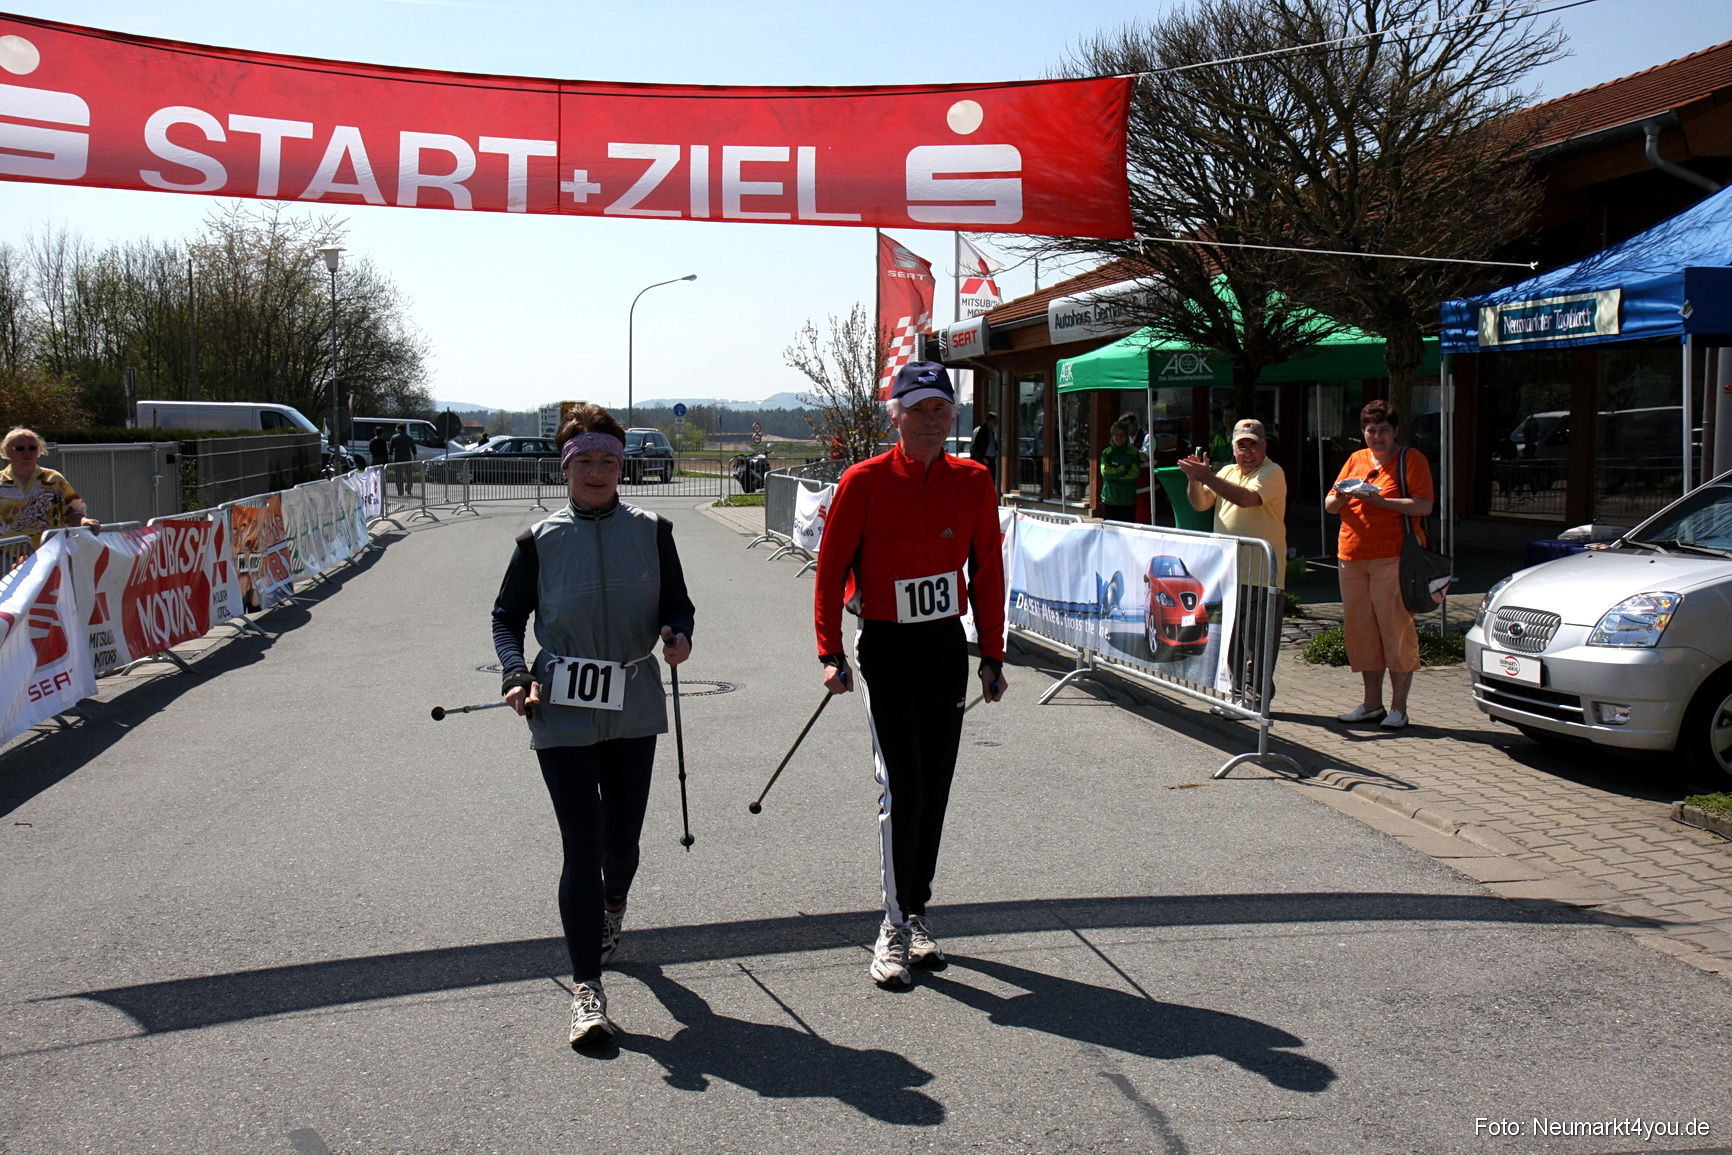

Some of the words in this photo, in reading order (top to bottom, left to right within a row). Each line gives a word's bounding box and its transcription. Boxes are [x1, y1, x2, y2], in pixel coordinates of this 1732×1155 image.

[887, 270, 927, 281] SEAT
[1055, 308, 1092, 330] Autohaus
[1503, 314, 1552, 335] Neumarkter
[1553, 307, 1592, 332] Tagblatt
[951, 328, 978, 349] SEAT
[1160, 353, 1214, 375] AOK
[904, 577, 951, 618] 103
[567, 661, 613, 704] 101
